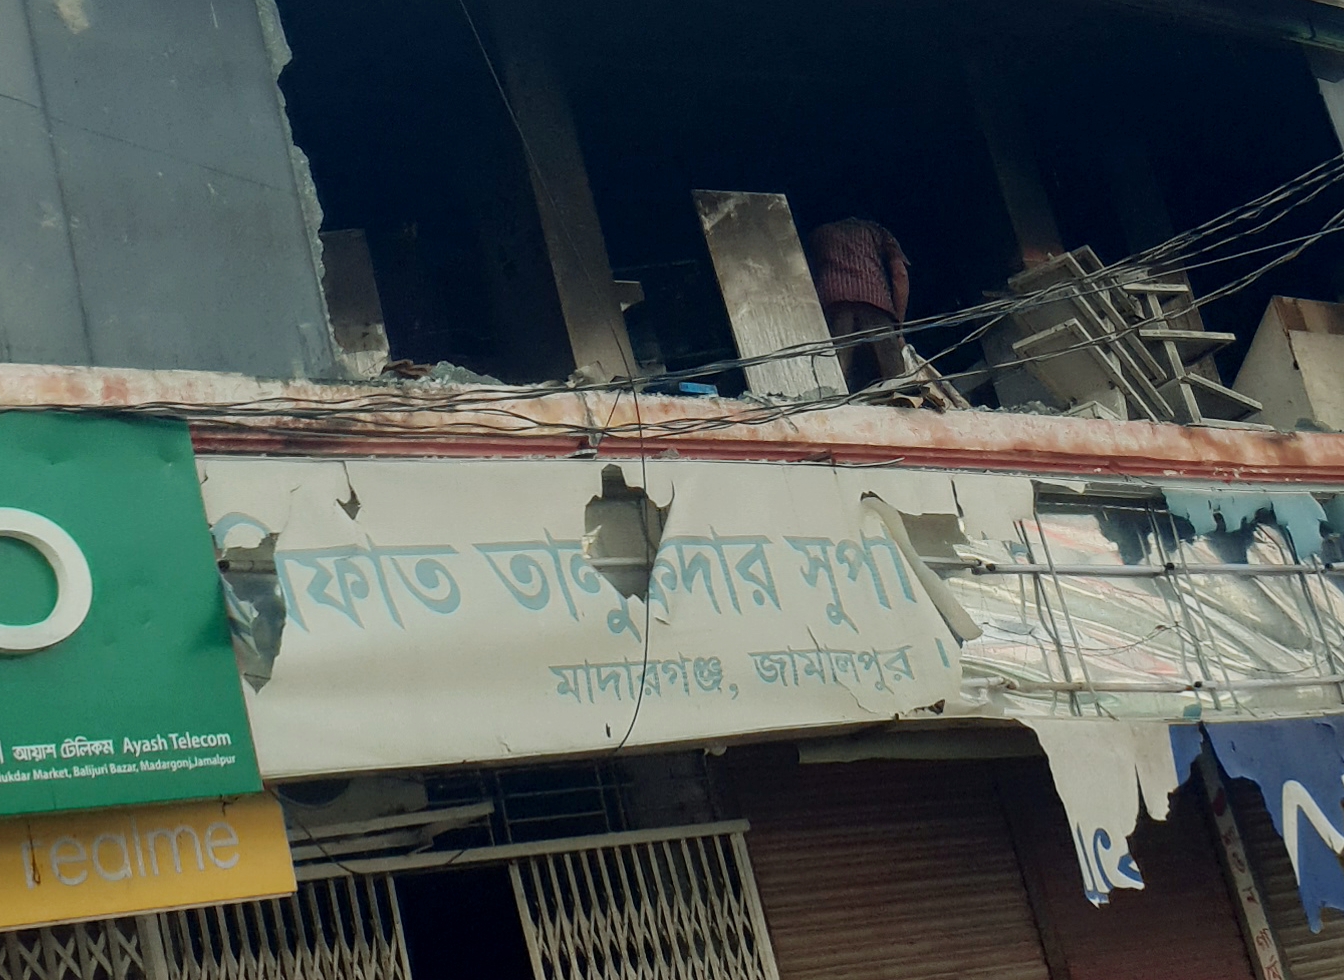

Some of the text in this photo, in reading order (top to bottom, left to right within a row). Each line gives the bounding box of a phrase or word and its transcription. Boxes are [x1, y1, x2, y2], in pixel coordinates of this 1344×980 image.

[12, 743, 57, 763] আয়াশ
[61, 736, 115, 760] টেলিকম
[123, 734, 168, 756] Ayash
[170, 730, 232, 750] Telecom
[33, 766, 71, 781] Market,
[73, 763, 109, 779] Balijuri
[109, 760, 138, 776] Bazar,
[23, 817, 241, 891] realme
